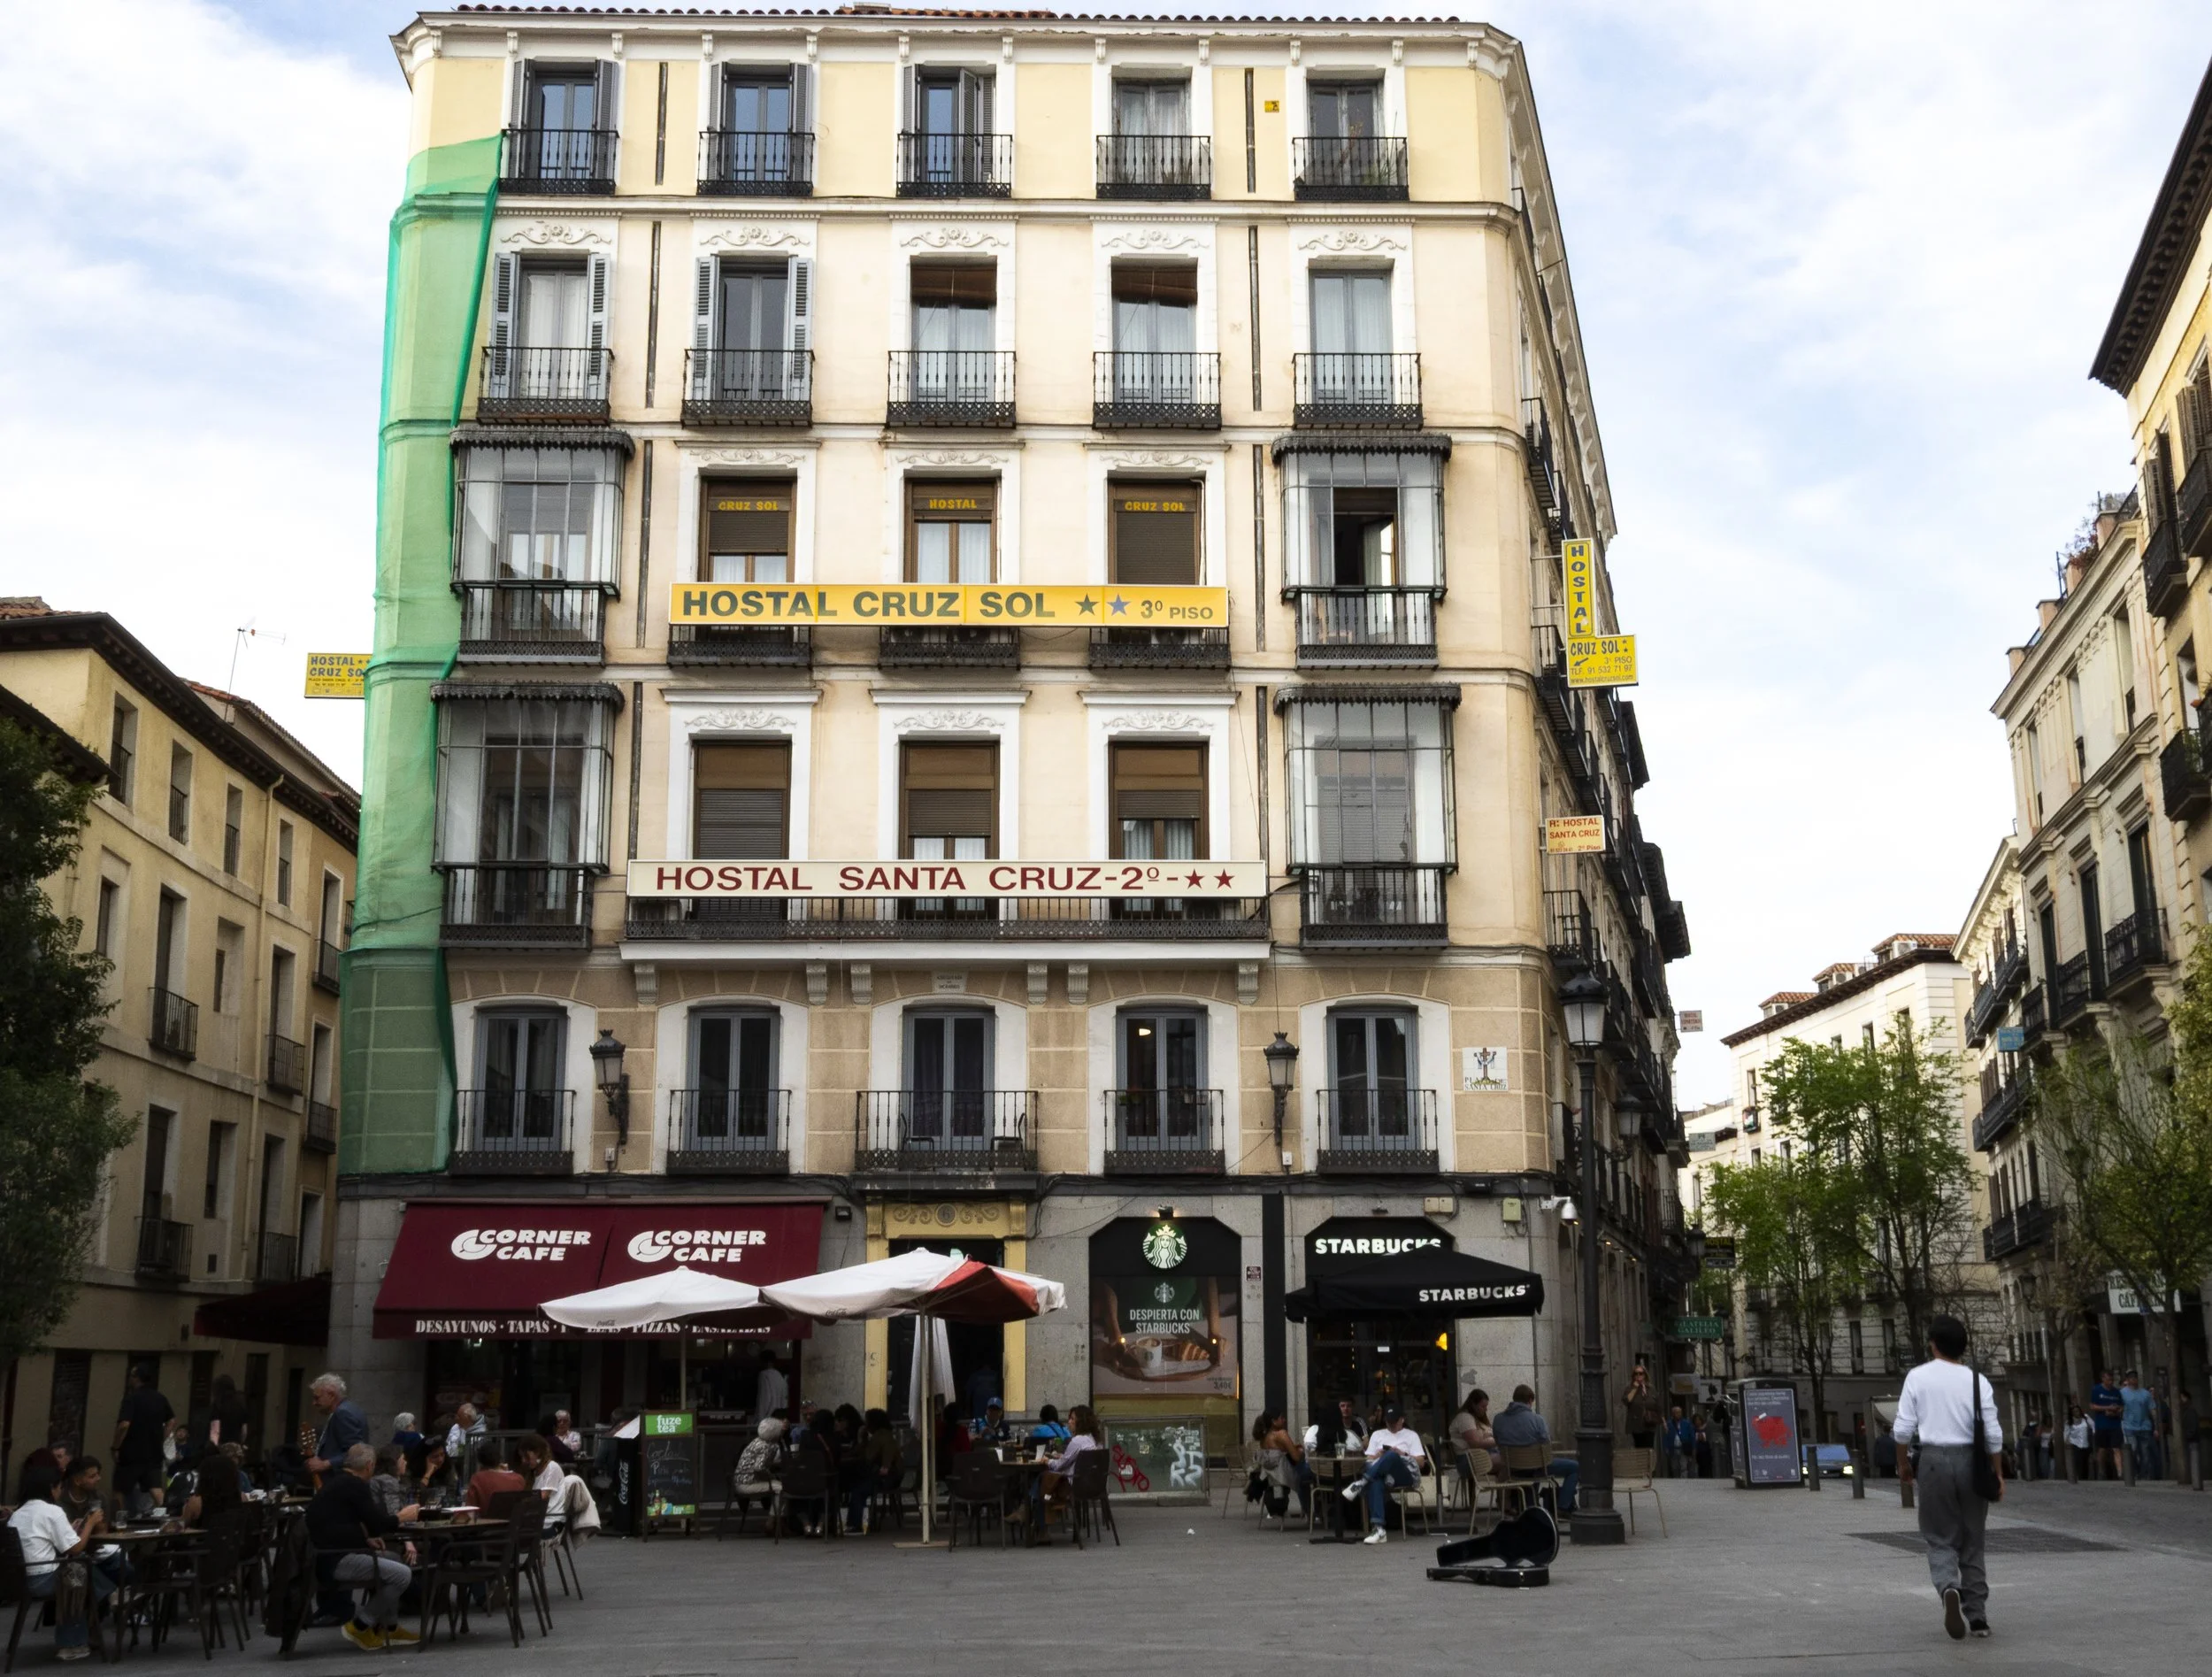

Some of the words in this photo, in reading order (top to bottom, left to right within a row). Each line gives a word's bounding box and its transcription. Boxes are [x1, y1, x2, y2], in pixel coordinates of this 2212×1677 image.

[718, 501, 750, 511] CRUZ
[755, 501, 779, 511] SOL
[929, 499, 977, 510] HOSTAL
[1124, 502, 1157, 512] CRUZ
[1162, 502, 1186, 512] SOL
[1570, 545, 1588, 634] HOSTAL
[682, 590, 837, 618] HOSTAL
[853, 590, 960, 618] CRUZ
[979, 591, 1056, 619] SOL
[1168, 606, 1213, 620] PISO
[1570, 642, 1597, 656] CRUZ
[1601, 640, 1620, 654] SOL
[311, 656, 355, 665] HOSTAL
[310, 667, 342, 677] CRUZ
[347, 668, 364, 678] SO
[1563, 818, 1600, 827] HOSTAL
[1549, 830, 1577, 839] SANTA
[657, 866, 812, 891] HOSTAL
[839, 866, 966, 891] SANTA
[479, 1229, 591, 1245] CORNER
[655, 1230, 766, 1246] CORNER
[496, 1246, 567, 1262] CAFE
[672, 1247, 743, 1263] CAFE
[1418, 1283, 1527, 1303] STARBUCKS
[1129, 1309, 1178, 1321] DESPIERTA
[1179, 1309, 1200, 1321] CON
[415, 1319, 497, 1335] DESAYUNOS
[507, 1319, 550, 1334] TAPAS
[1135, 1322, 1191, 1335] STARBUCKS
[657, 1414, 681, 1426] fuze
[657, 1424, 676, 1433] tea
